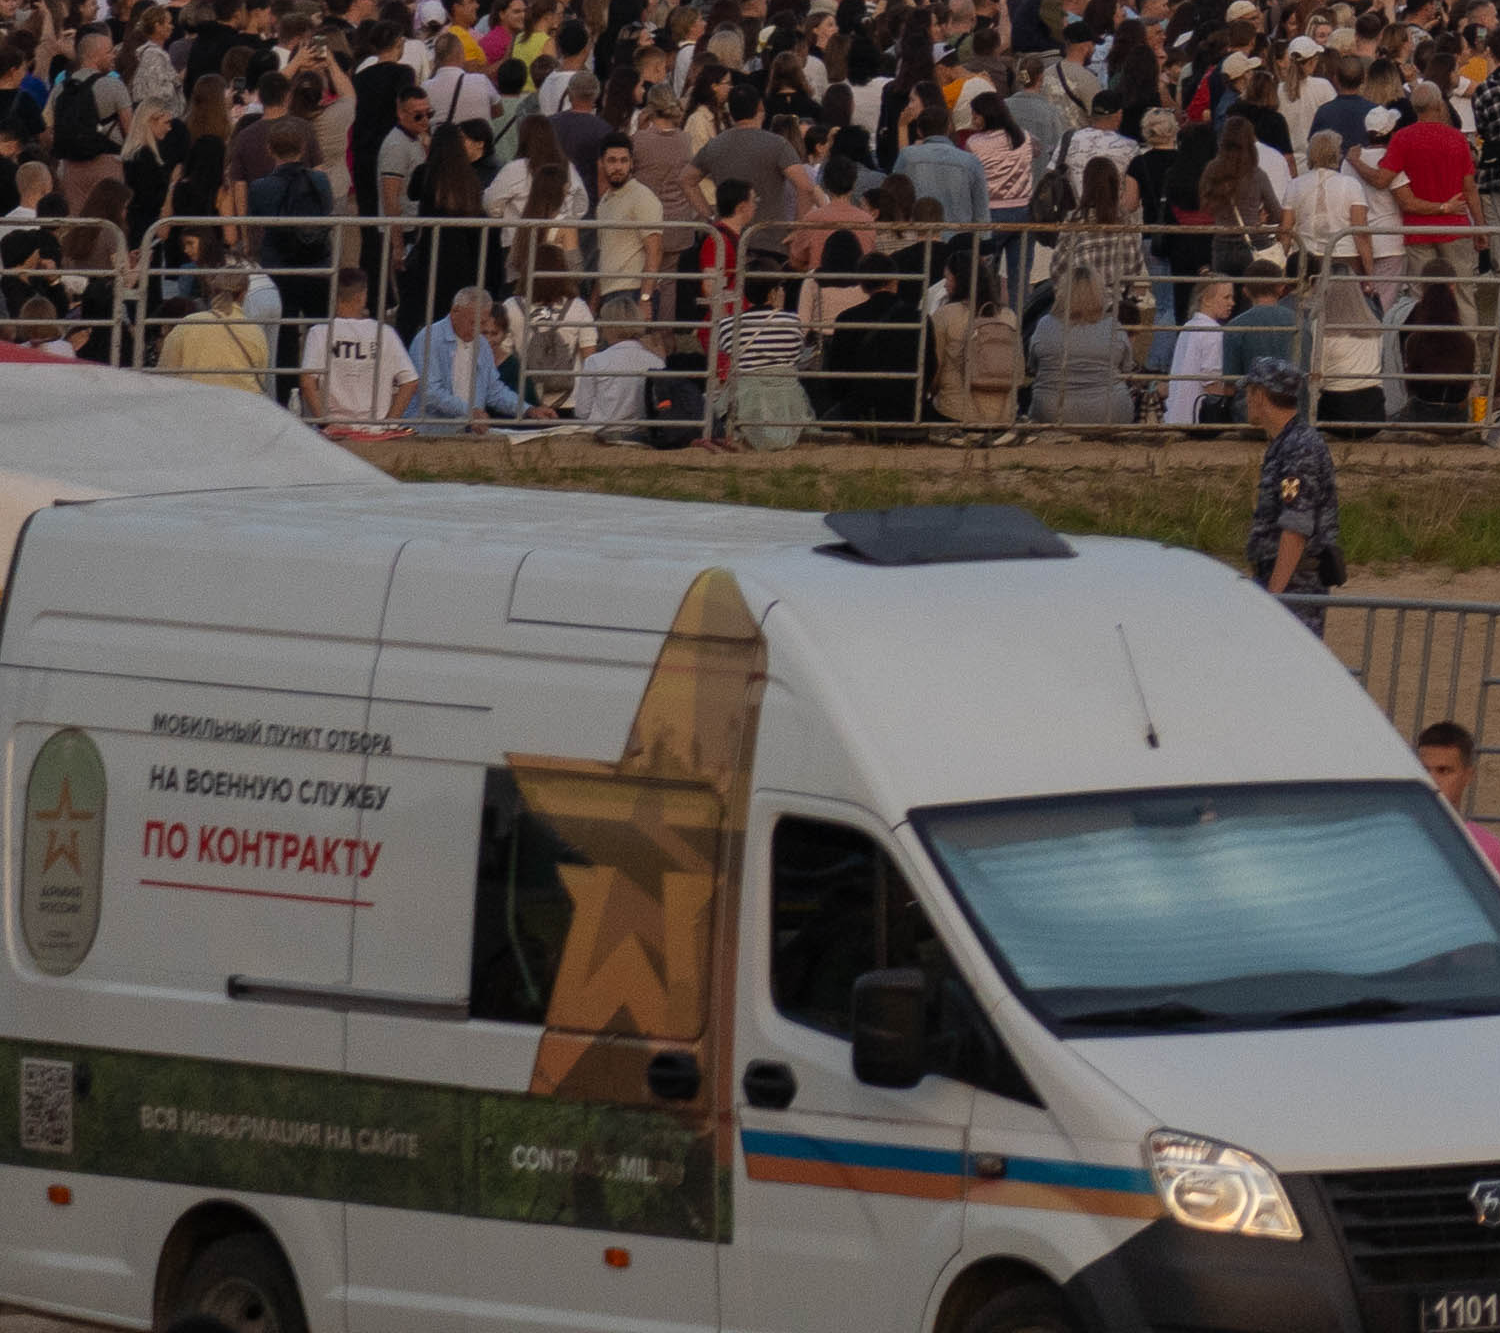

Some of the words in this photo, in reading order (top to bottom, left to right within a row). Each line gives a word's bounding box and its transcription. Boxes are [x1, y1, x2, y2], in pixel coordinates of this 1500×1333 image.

[152, 713, 262, 743] МОБИЛЬНЫЙ
[266, 724, 323, 748] ПУНКТ
[327, 729, 393, 755] ОТБОРА
[150, 765, 179, 792] НА
[184, 768, 293, 802] ВОЕННУЮ
[299, 780, 391, 811] СЛУЖБУ
[143, 820, 189, 860] ПО
[197, 825, 384, 878] КОНТРАКТУ
[140, 1105, 178, 1131] ВСЯ
[182, 1109, 322, 1147] ИНФОРМАЦИЯ
[325, 1125, 352, 1150] НА
[356, 1126, 419, 1159] САЙТЕ
